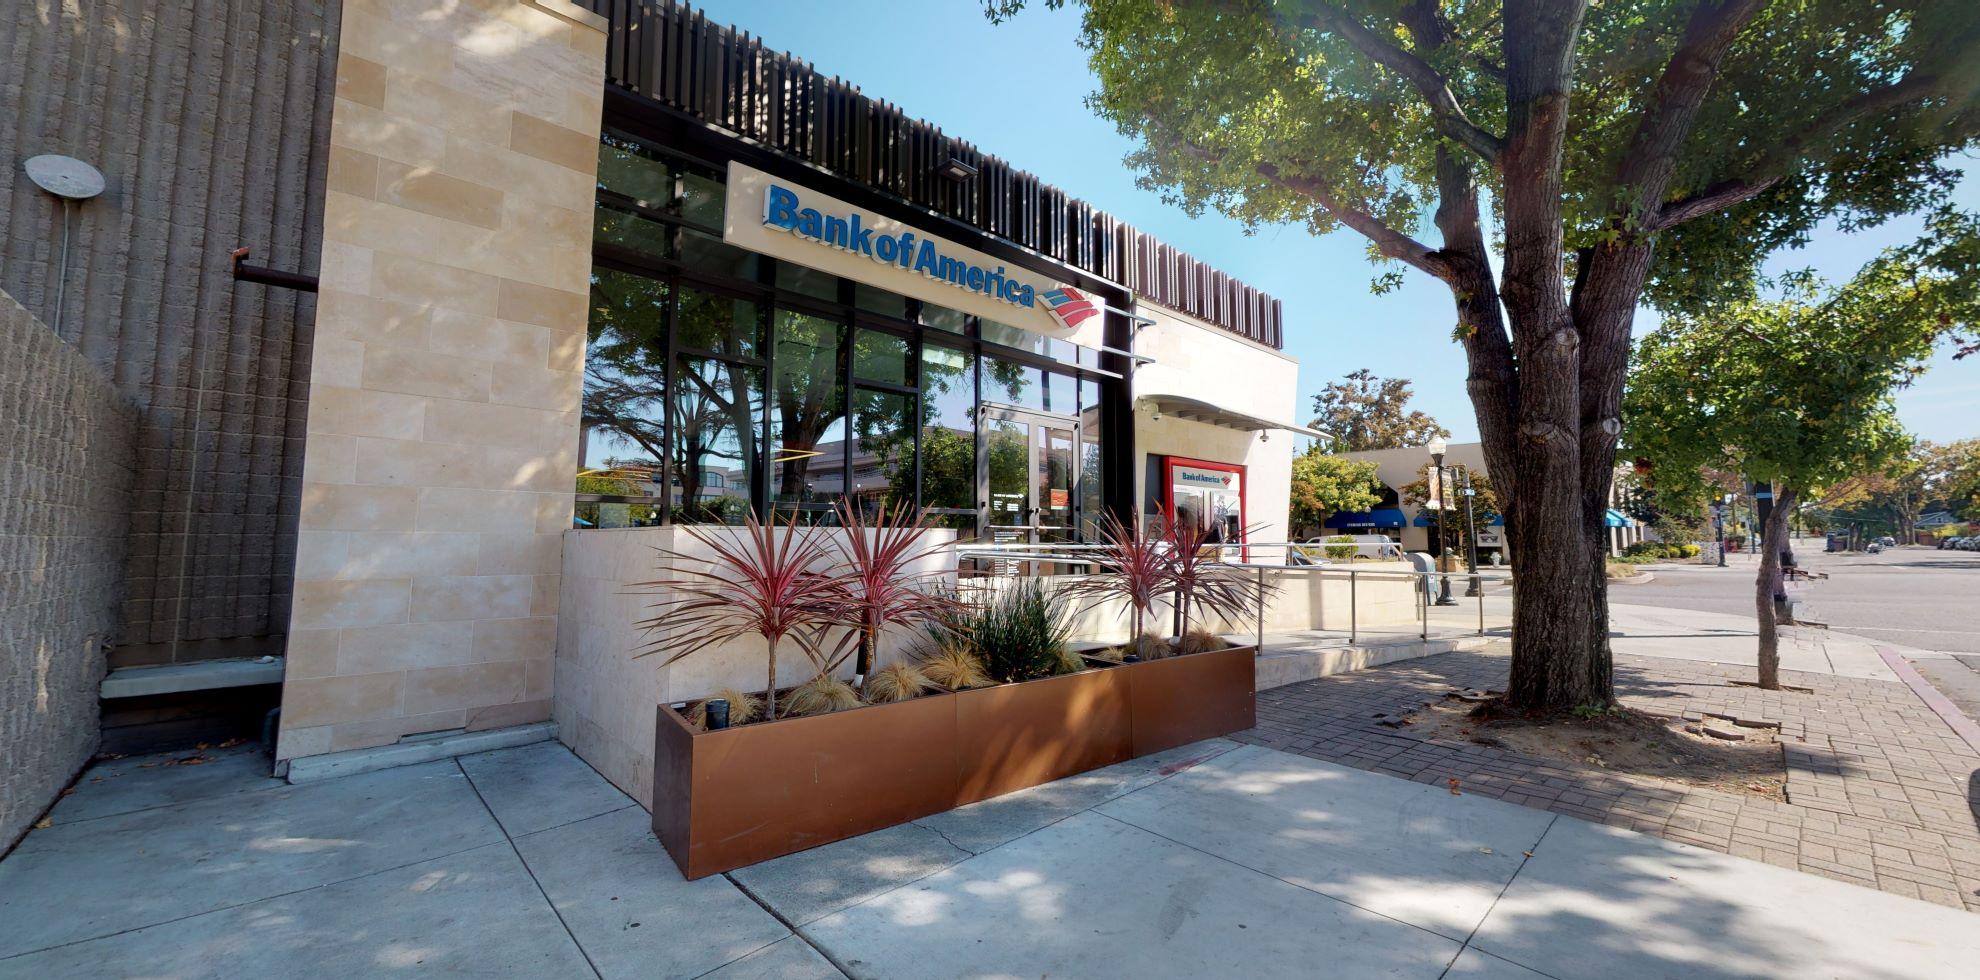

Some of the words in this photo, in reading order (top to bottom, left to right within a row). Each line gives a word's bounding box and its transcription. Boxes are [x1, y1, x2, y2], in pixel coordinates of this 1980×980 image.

[766, 185, 874, 255] Bank
[875, 233, 915, 269] of
[914, 239, 1035, 308] America
[1182, 472, 1195, 480] Bank
[1201, 474, 1220, 483] America
